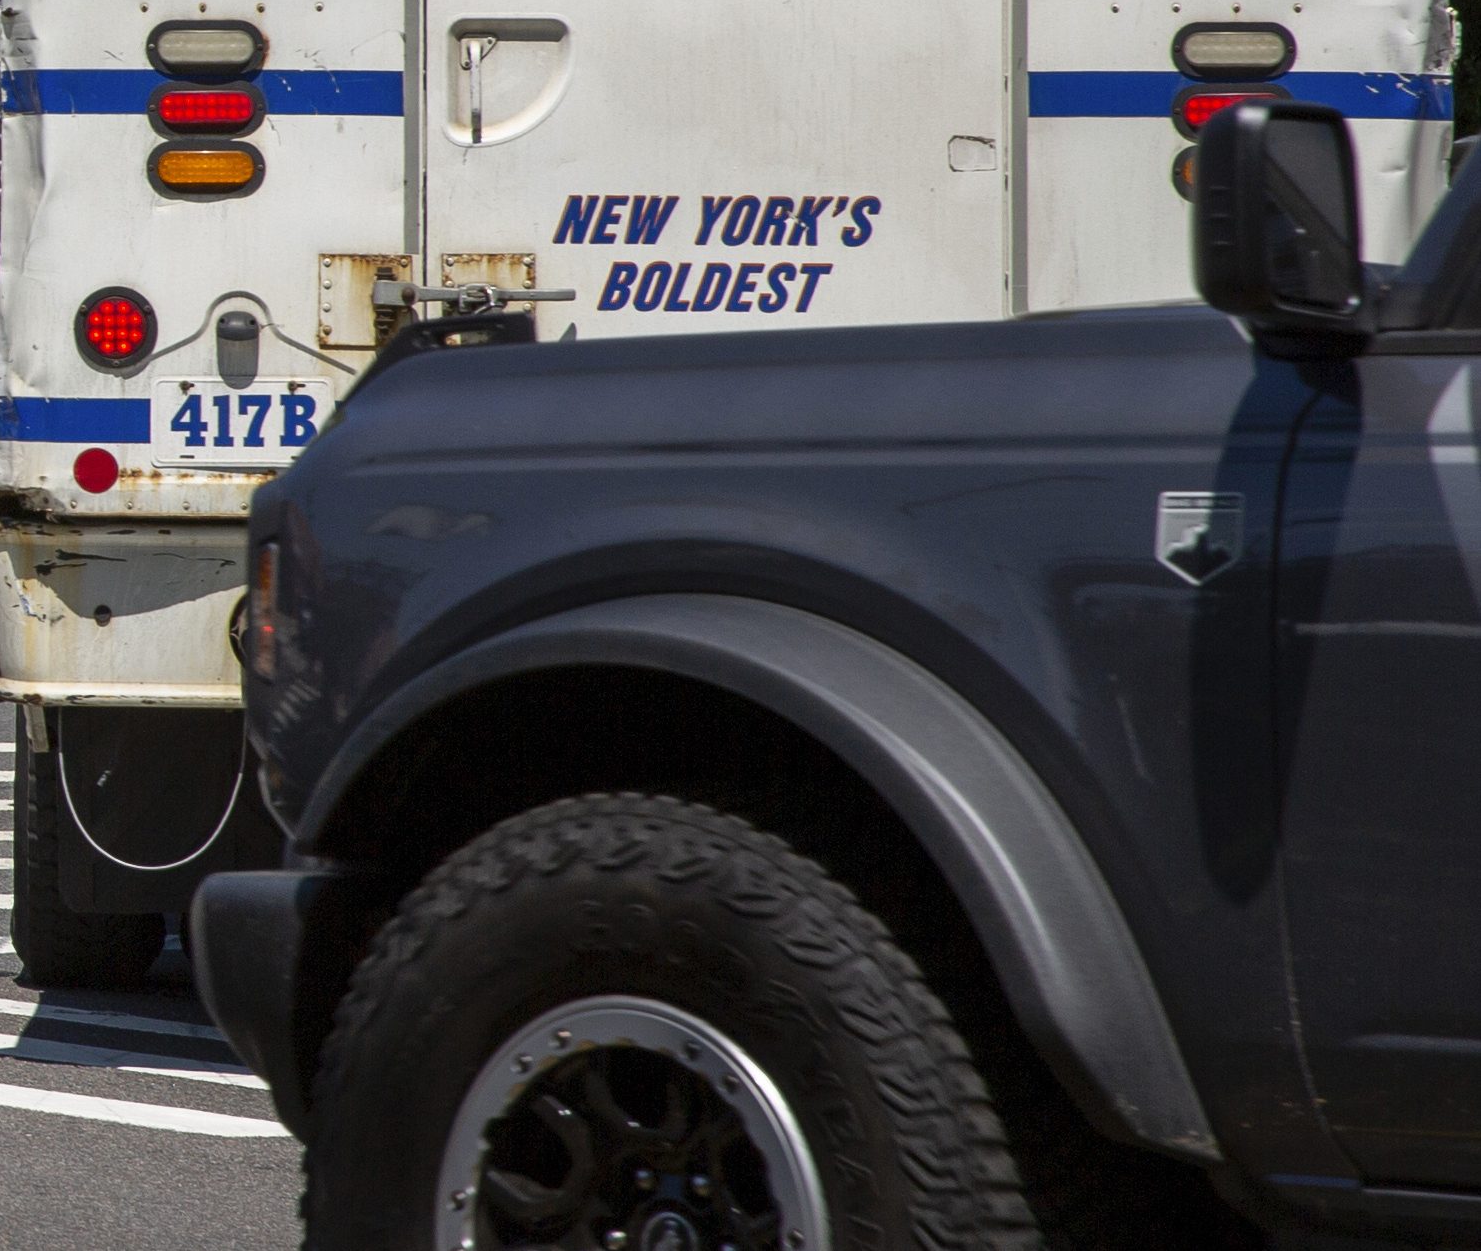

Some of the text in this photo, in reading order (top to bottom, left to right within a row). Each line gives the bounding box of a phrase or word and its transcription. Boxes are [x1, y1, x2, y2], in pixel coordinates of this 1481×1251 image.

[552, 195, 882, 247] NEW YORK'S
[597, 261, 833, 313] BOLDEST
[169, 394, 318, 448] 417B
